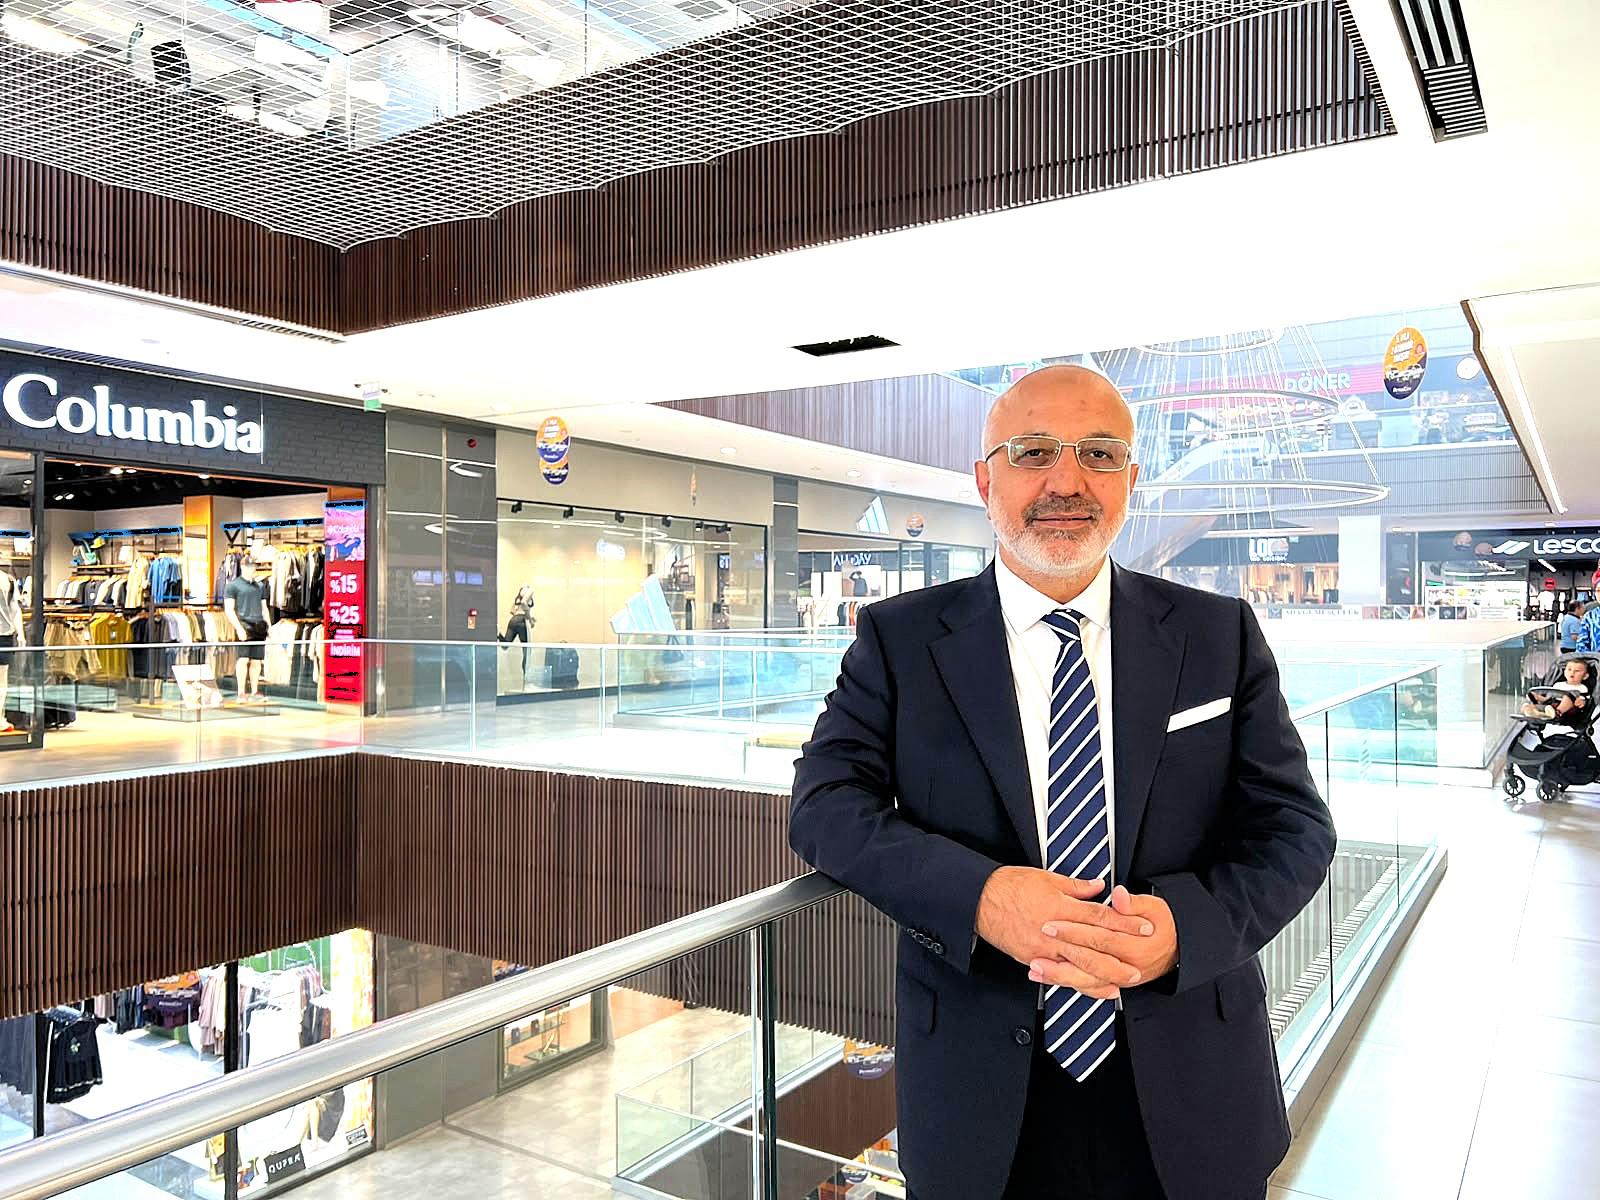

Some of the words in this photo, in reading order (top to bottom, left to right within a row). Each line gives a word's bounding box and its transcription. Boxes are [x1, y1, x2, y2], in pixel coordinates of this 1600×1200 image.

[1284, 372, 1351, 392] DÖNER
[2, 373, 263, 454] Columbia
[330, 574, 358, 594] %15
[330, 605, 360, 625] %25
